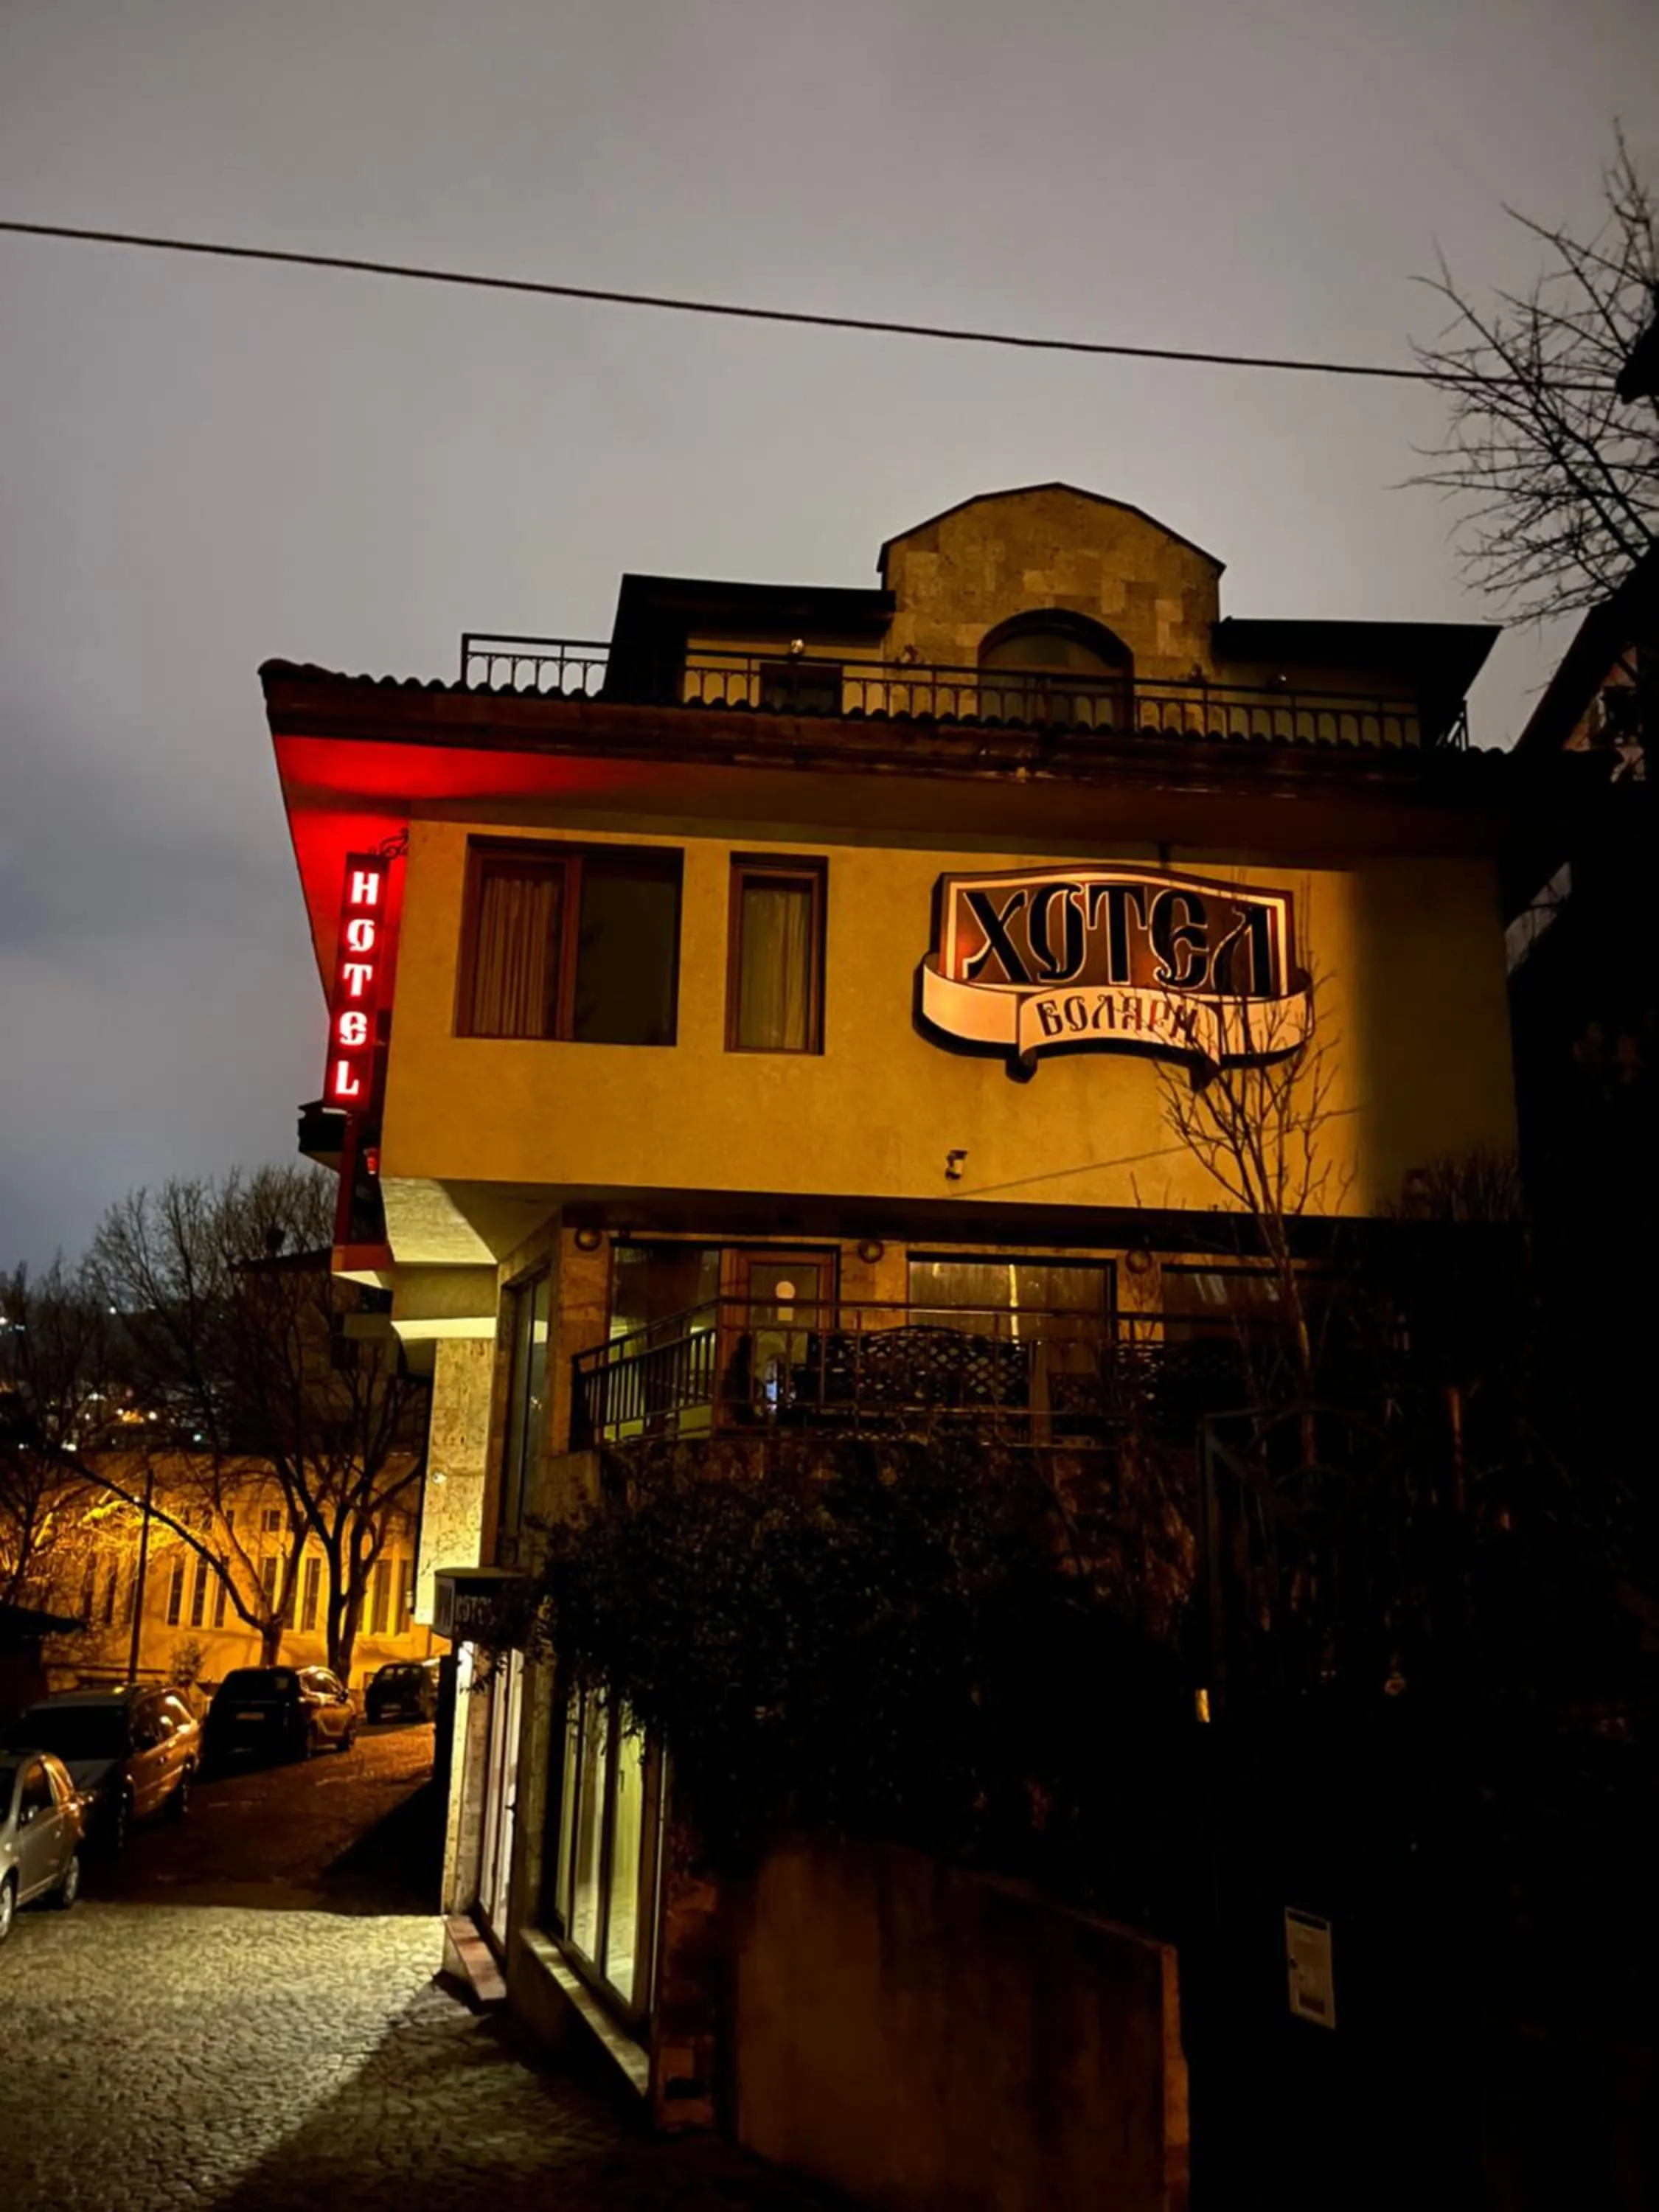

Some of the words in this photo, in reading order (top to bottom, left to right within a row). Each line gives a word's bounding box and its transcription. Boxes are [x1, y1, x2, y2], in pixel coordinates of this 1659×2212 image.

[335, 871, 380, 1096] HOTEL
[964, 881, 1273, 997] ХОТЕЛ
[1035, 994, 1198, 1043] БОЛЯРИ
